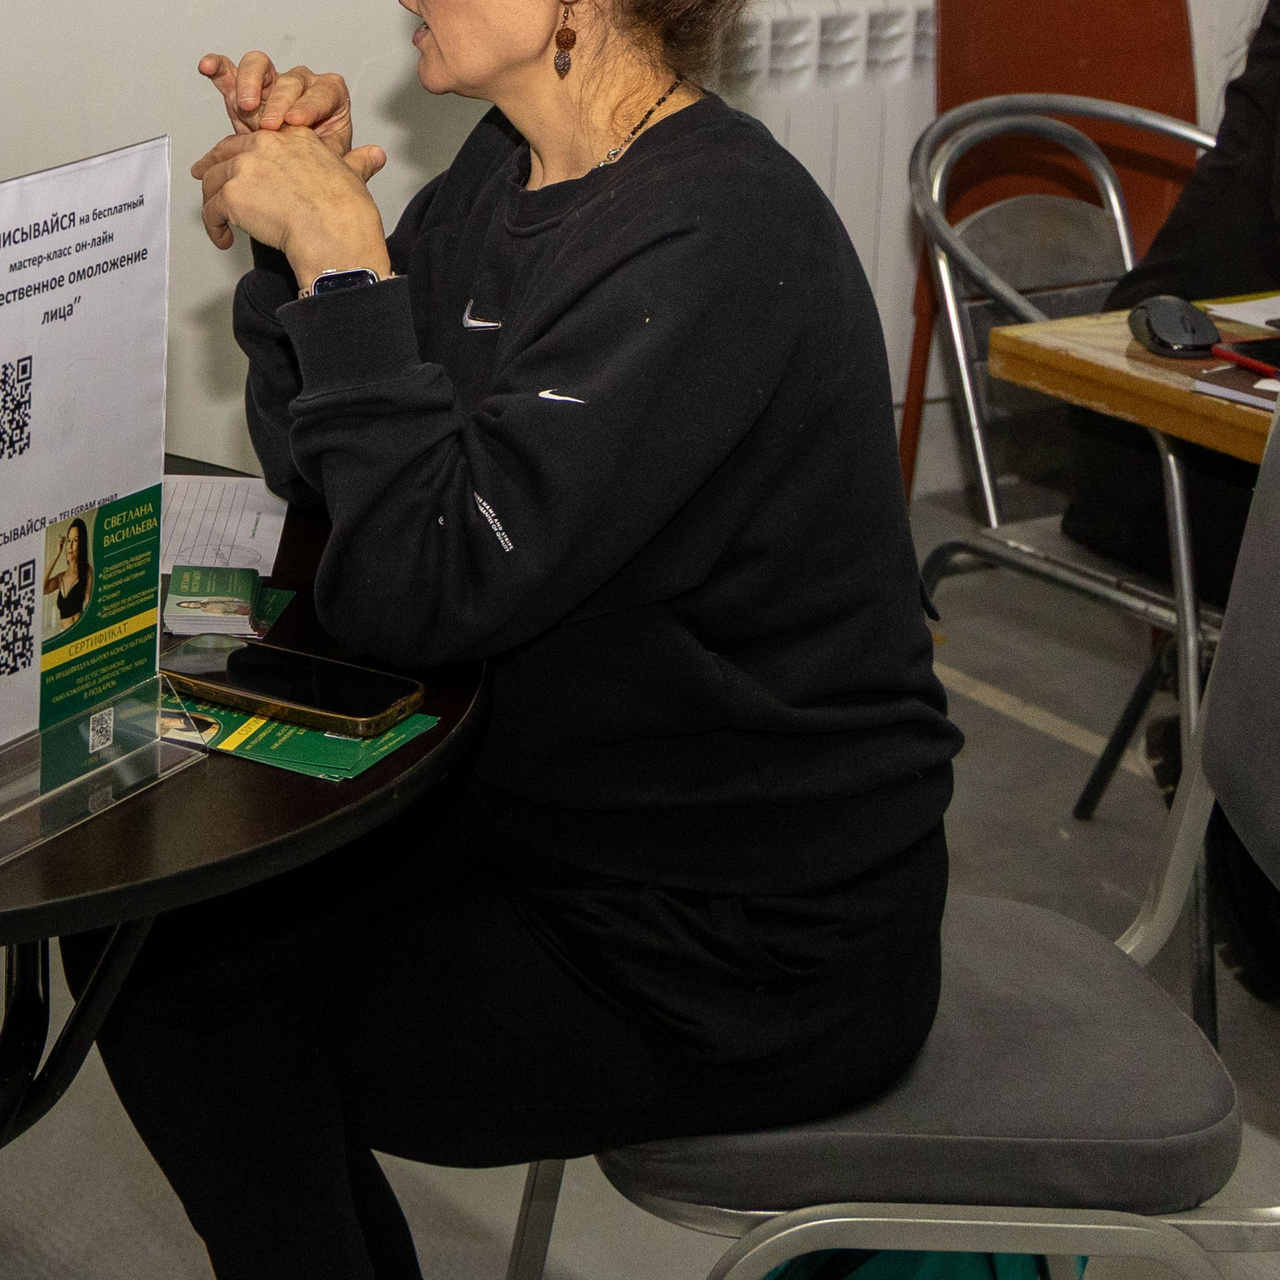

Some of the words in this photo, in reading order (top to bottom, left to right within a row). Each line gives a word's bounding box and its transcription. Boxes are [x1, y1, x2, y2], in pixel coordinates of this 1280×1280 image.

[79, 215, 90, 226] на
[92, 194, 144, 222] бесплатный
[9, 245, 72, 273] мастер-класс
[75, 231, 114, 254] он-лайн
[67, 248, 148, 284] омоложение
[102, 517, 158, 547] ВАСИЛЬЕВА
[103, 502, 153, 530] СВЕТЛАНА
[68, 622, 128, 657] СЕРТИФИКАТ
